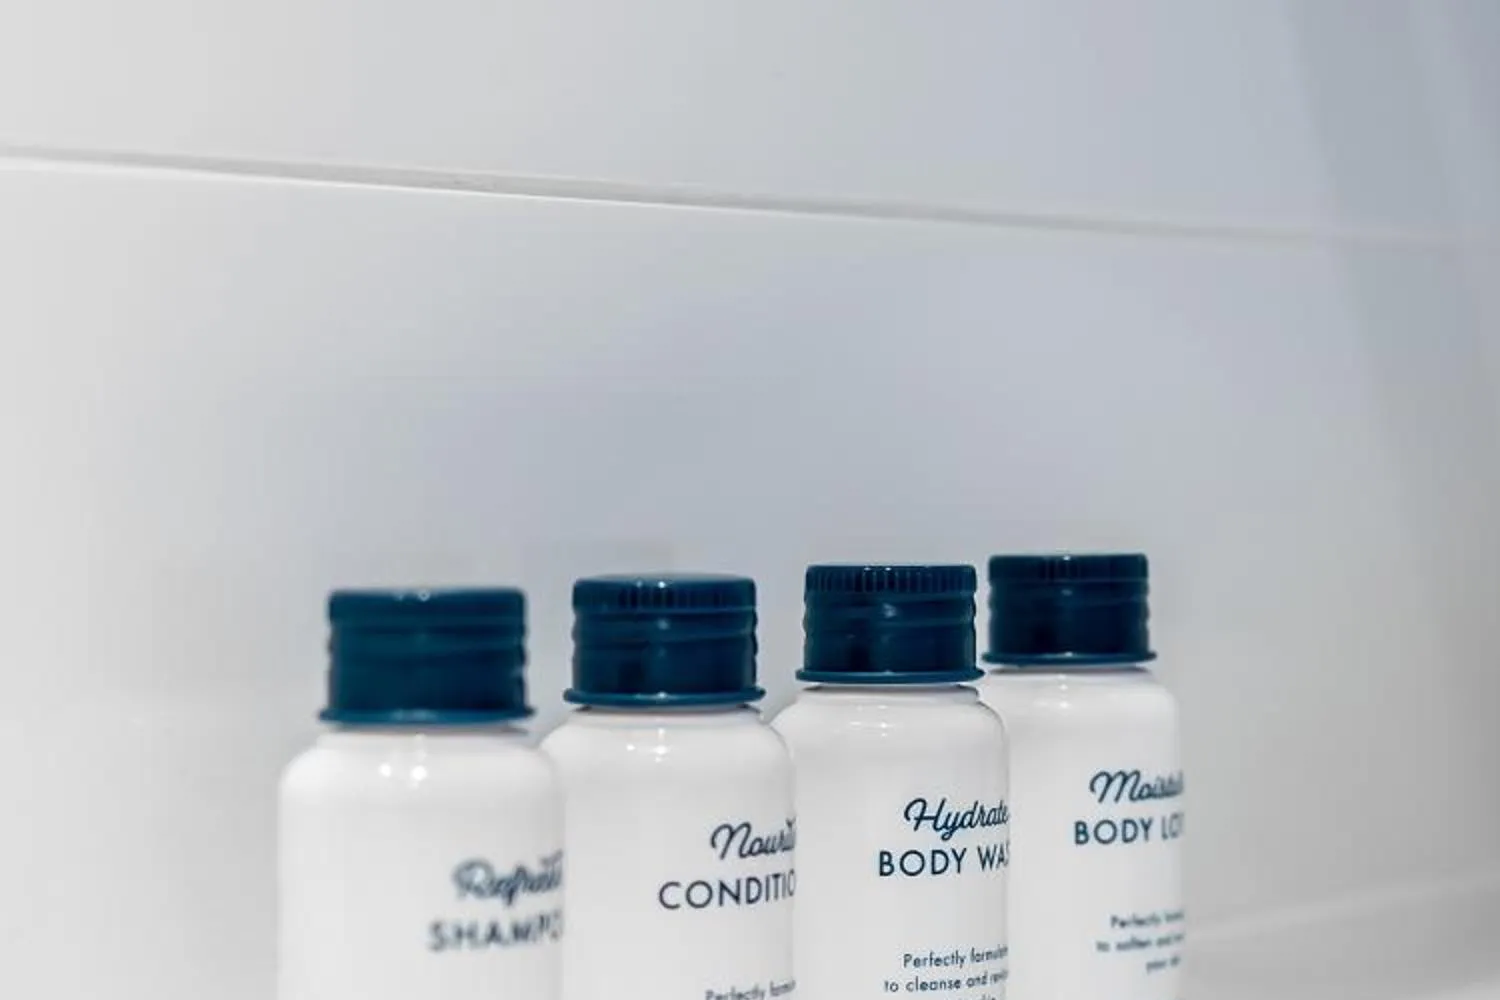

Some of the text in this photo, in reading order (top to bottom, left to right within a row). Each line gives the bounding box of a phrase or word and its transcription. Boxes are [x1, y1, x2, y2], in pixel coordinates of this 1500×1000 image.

[1075, 816, 1153, 846] BODY
[879, 847, 967, 876] BODY
[903, 950, 966, 968] Perfectly
[884, 980, 899, 993] to
[906, 976, 961, 992] cleanse
[966, 969, 988, 988] and
